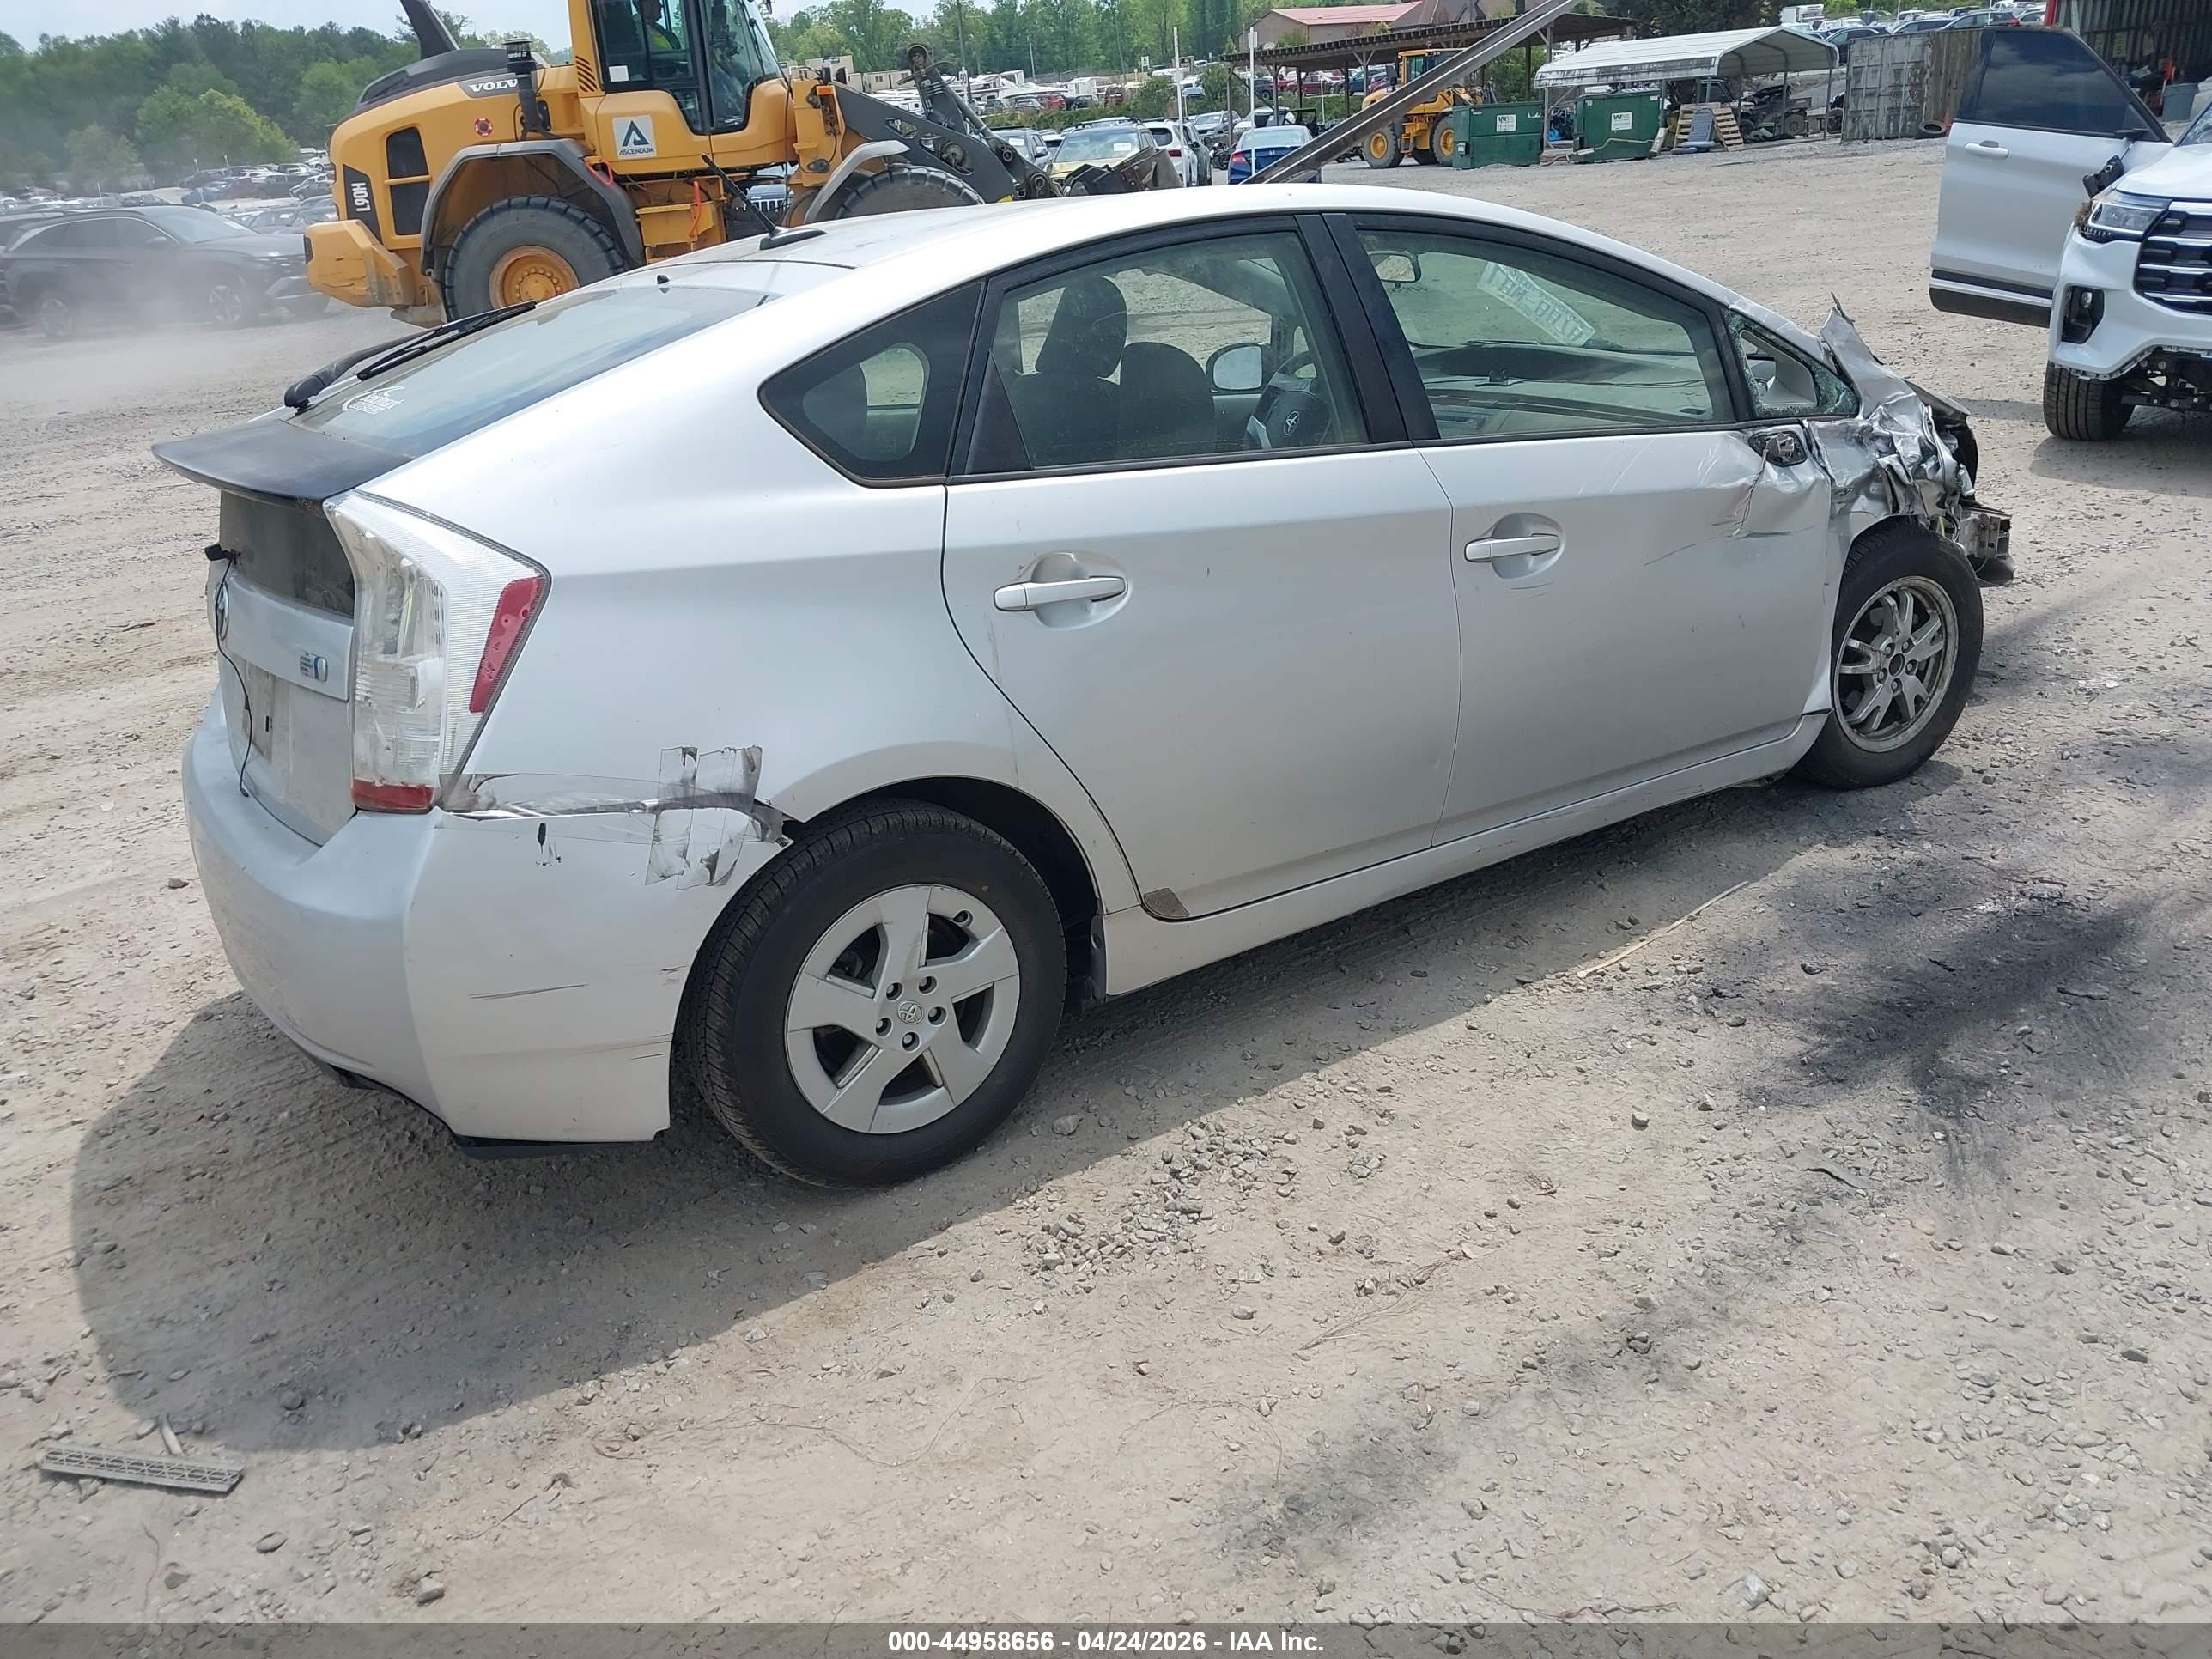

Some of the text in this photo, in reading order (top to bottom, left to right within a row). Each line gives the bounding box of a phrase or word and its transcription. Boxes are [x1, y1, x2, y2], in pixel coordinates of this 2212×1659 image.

[469, 78, 518, 92] VOLV
[618, 147, 655, 155] ASCENDUM
[351, 182, 371, 212] L90H
